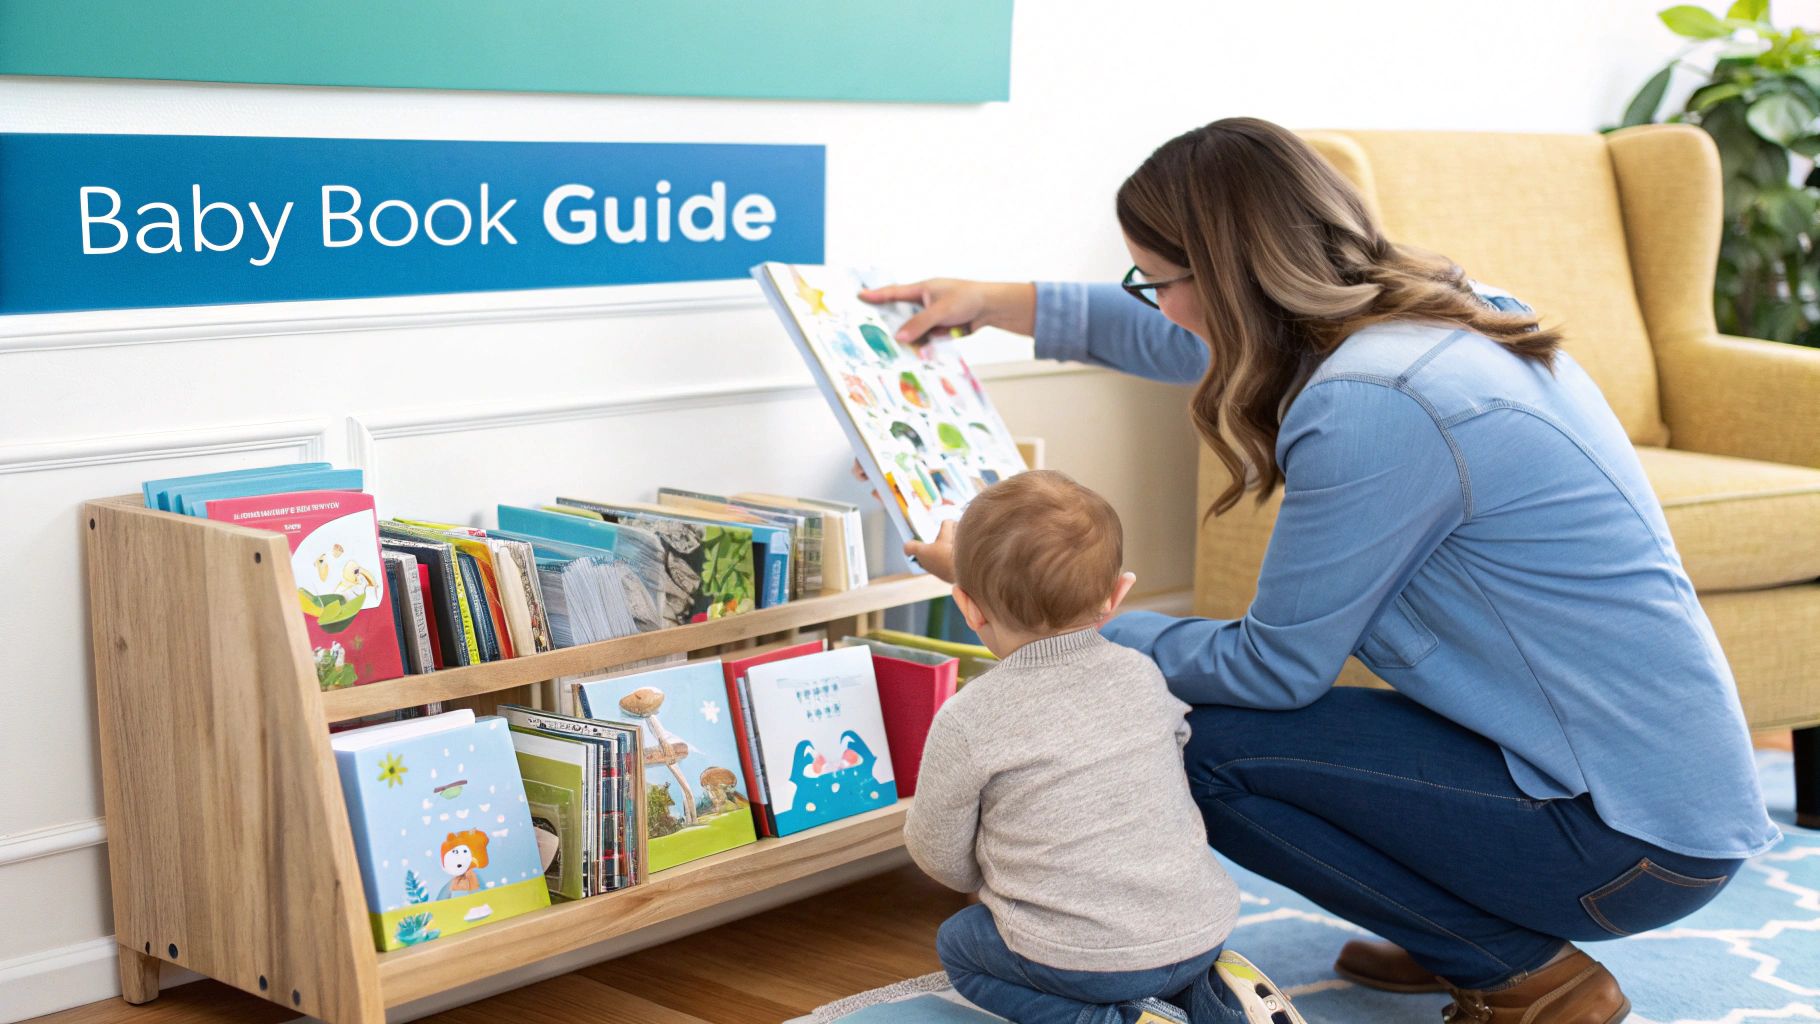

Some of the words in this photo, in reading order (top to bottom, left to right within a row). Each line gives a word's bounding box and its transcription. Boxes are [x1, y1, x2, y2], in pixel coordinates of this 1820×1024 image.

[79, 184, 294, 266] Baby
[321, 183, 518, 247] Book
[543, 181, 777, 244] Guide
